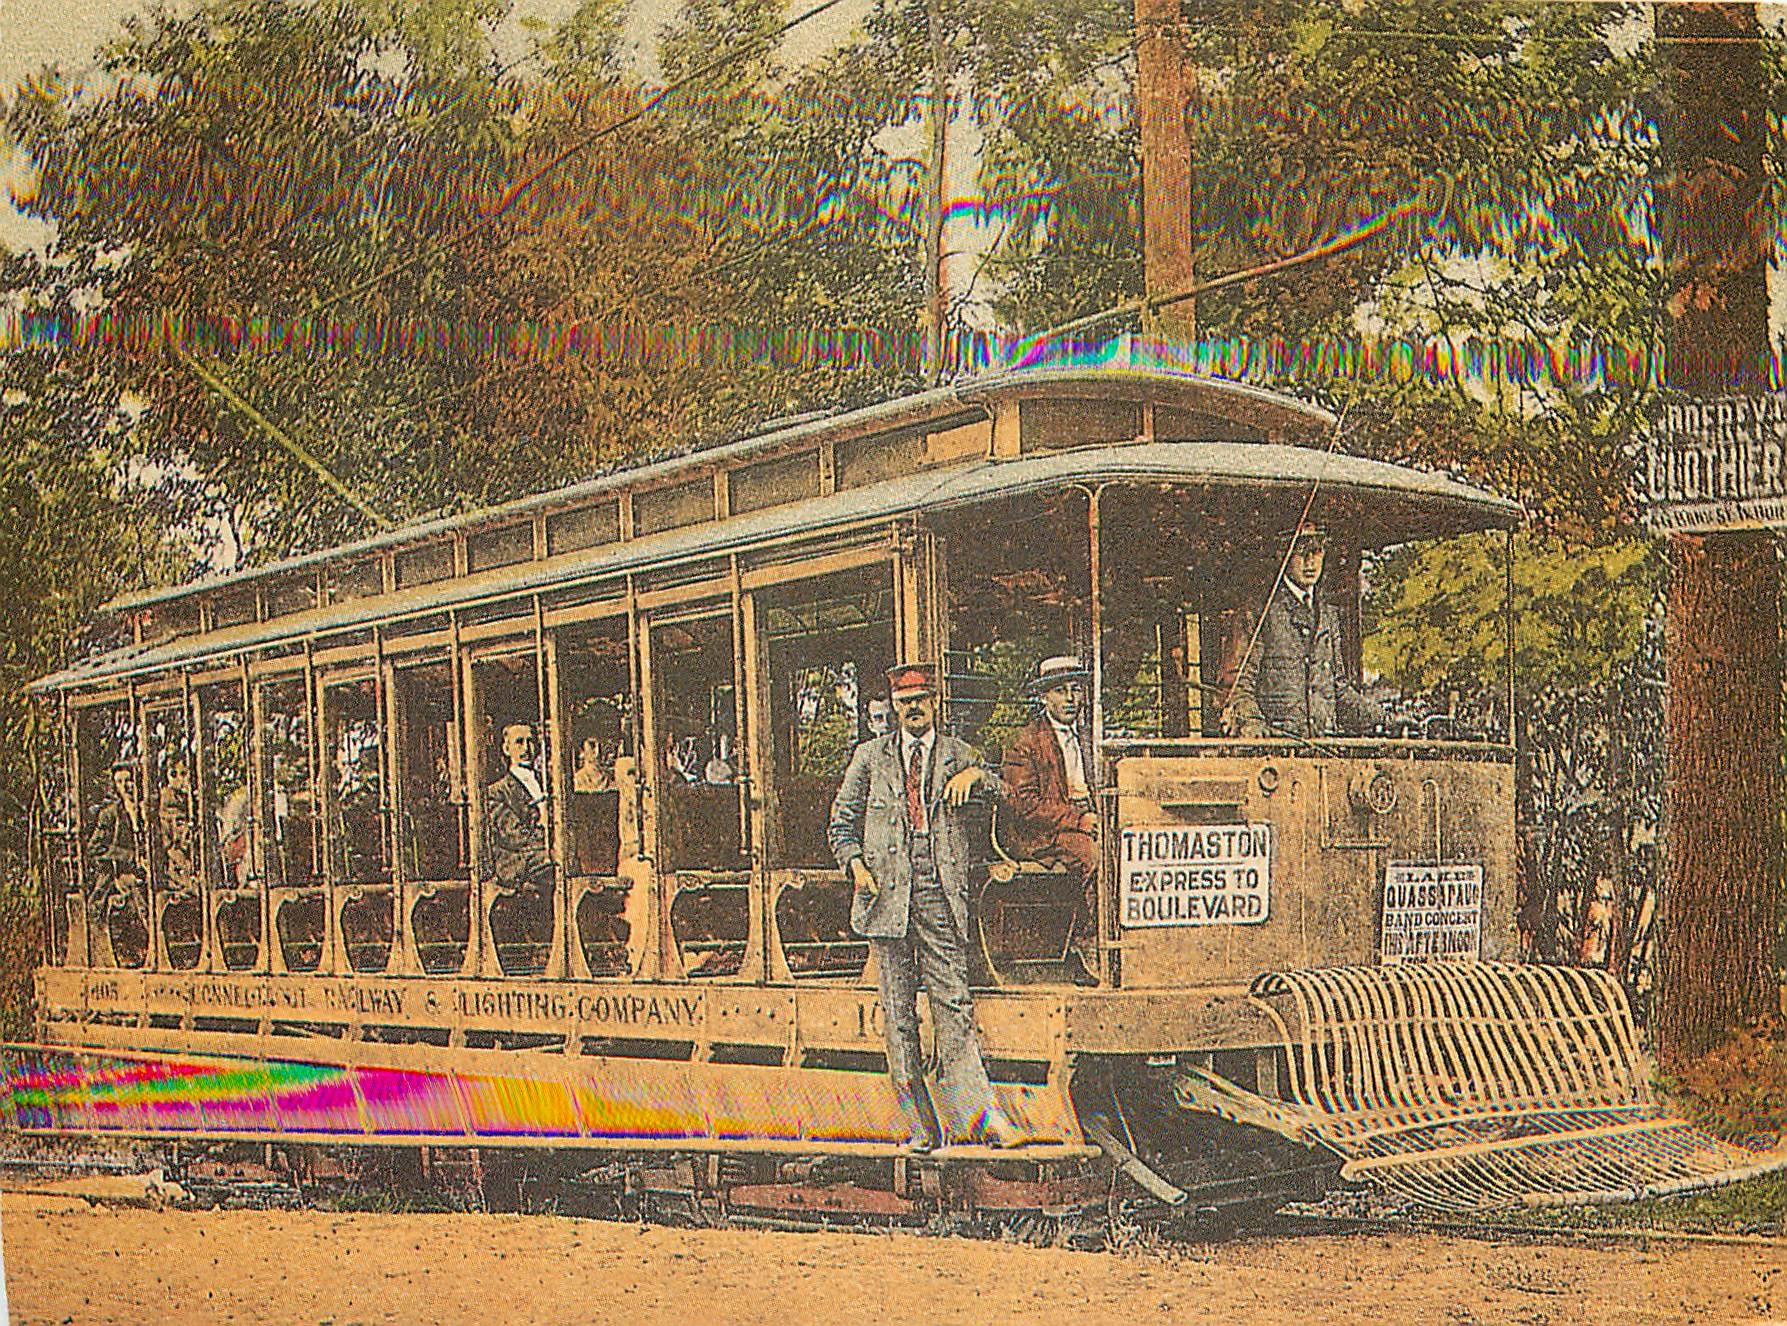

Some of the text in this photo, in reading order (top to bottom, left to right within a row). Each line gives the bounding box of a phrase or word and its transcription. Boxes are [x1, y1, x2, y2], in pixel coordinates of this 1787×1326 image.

[1647, 443, 1784, 500] CLOTHIER
[1123, 830, 1267, 861] THOMASTON
[1130, 868, 1259, 892] EXPRESS TO
[1127, 894, 1261, 920] BOULEVARD
[1385, 909, 1479, 929] BAND CONCERT
[460, 990, 565, 1020] LIGHTING
[577, 995, 699, 1025] COMPANY
